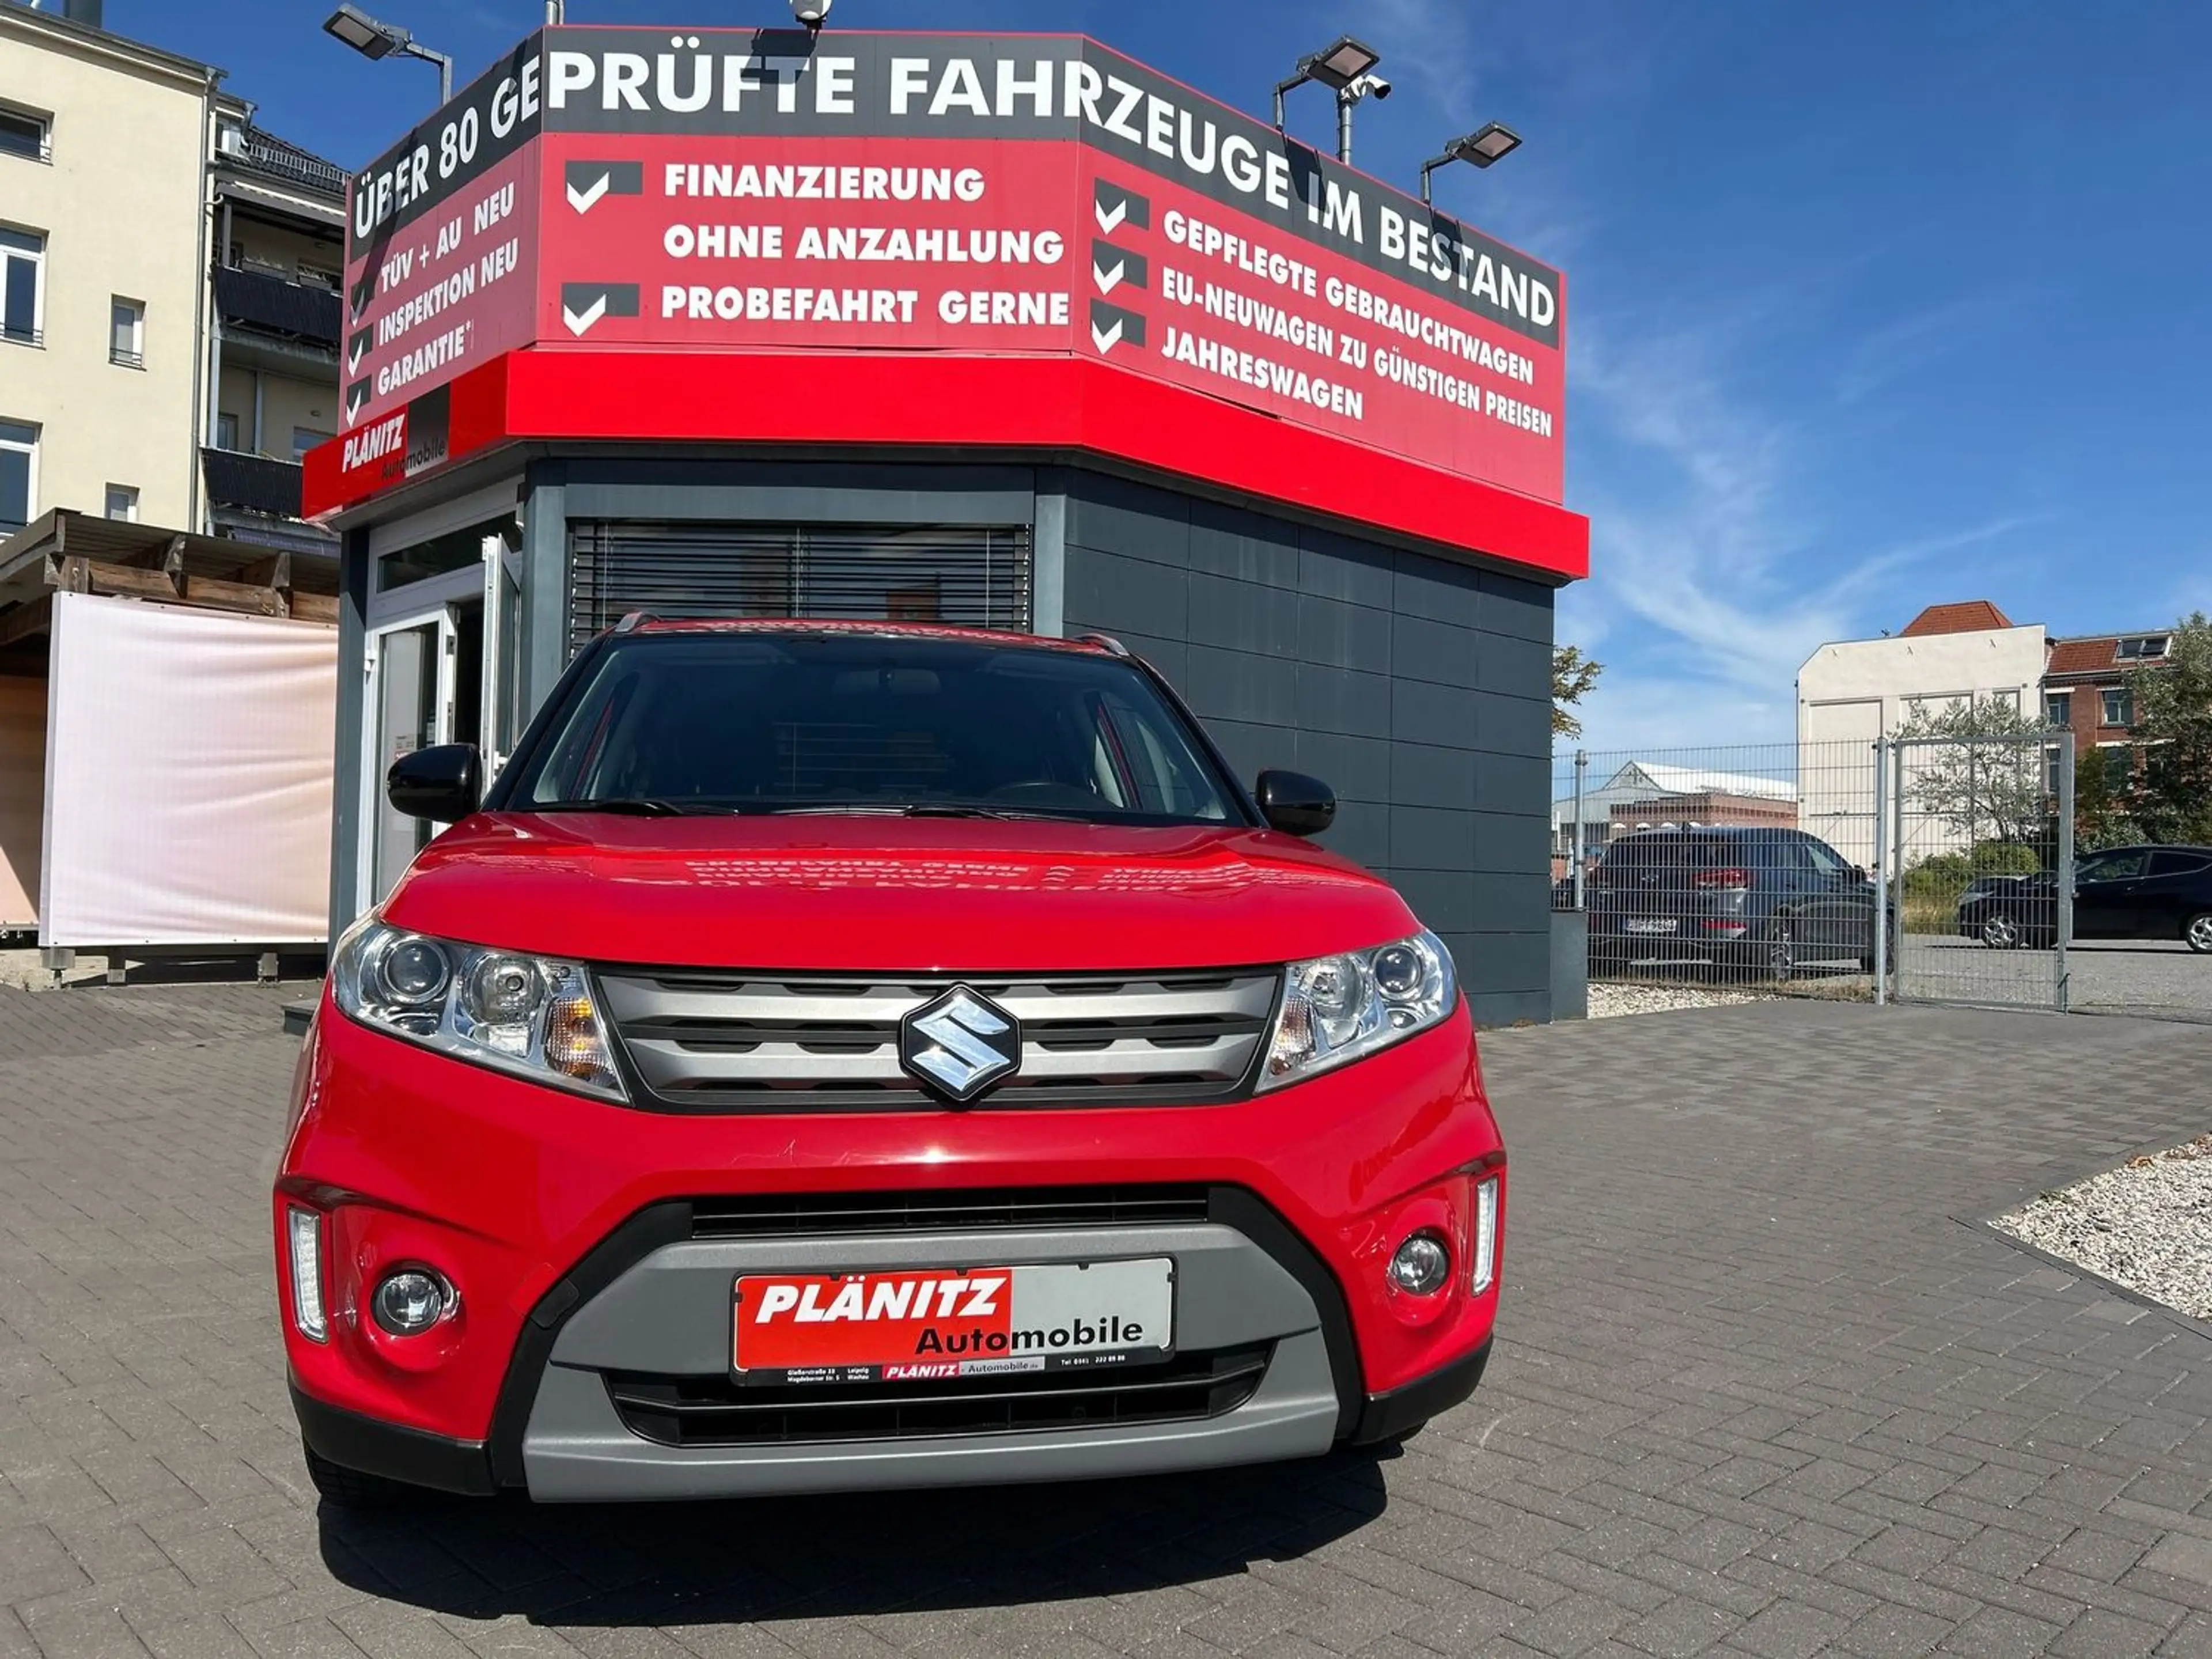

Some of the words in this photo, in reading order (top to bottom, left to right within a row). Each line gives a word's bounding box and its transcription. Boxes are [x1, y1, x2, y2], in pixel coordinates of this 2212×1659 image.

[355, 171, 429, 238] ÜBER
[439, 106, 478, 179] 80
[490, 36, 855, 138] GEPRÜFTE
[890, 58, 1289, 210] FAHRZEUGE
[1308, 171, 1363, 244] IM
[1381, 206, 1555, 327] BESTAND
[664, 164, 984, 201] FINANZIERUNG
[381, 248, 413, 293] TÜV
[419, 244, 430, 268] +
[436, 216, 461, 259] AU
[474, 181, 514, 233] NEU
[664, 224, 782, 258] OHNE
[795, 227, 1064, 264] ANZAHLUNG
[379, 264, 475, 346] INSPEKTION
[480, 238, 518, 287] NEU
[661, 286, 918, 322] PROBEFAHRT
[938, 291, 1070, 325] GERNE
[1163, 211, 1316, 297] GEPFLEGTE
[1325, 277, 1533, 385] GEBRAUCHTWAGEN
[1161, 328, 1363, 420] JAHRESWAGEN
[1162, 267, 1333, 358] EU-NEUWAGEN
[1339, 335, 1367, 369] ZU
[1373, 347, 1480, 412] GÜNSTIGEN
[1486, 391, 1551, 438] PREISEN
[342, 413, 405, 473] PLÄNITZ
[381, 437, 445, 479] Automobile
[755, 1275, 1009, 1324] PLÄNITZ
[915, 1317, 1143, 1355] Automobile
[887, 1363, 957, 1378] PLÄNITZ
